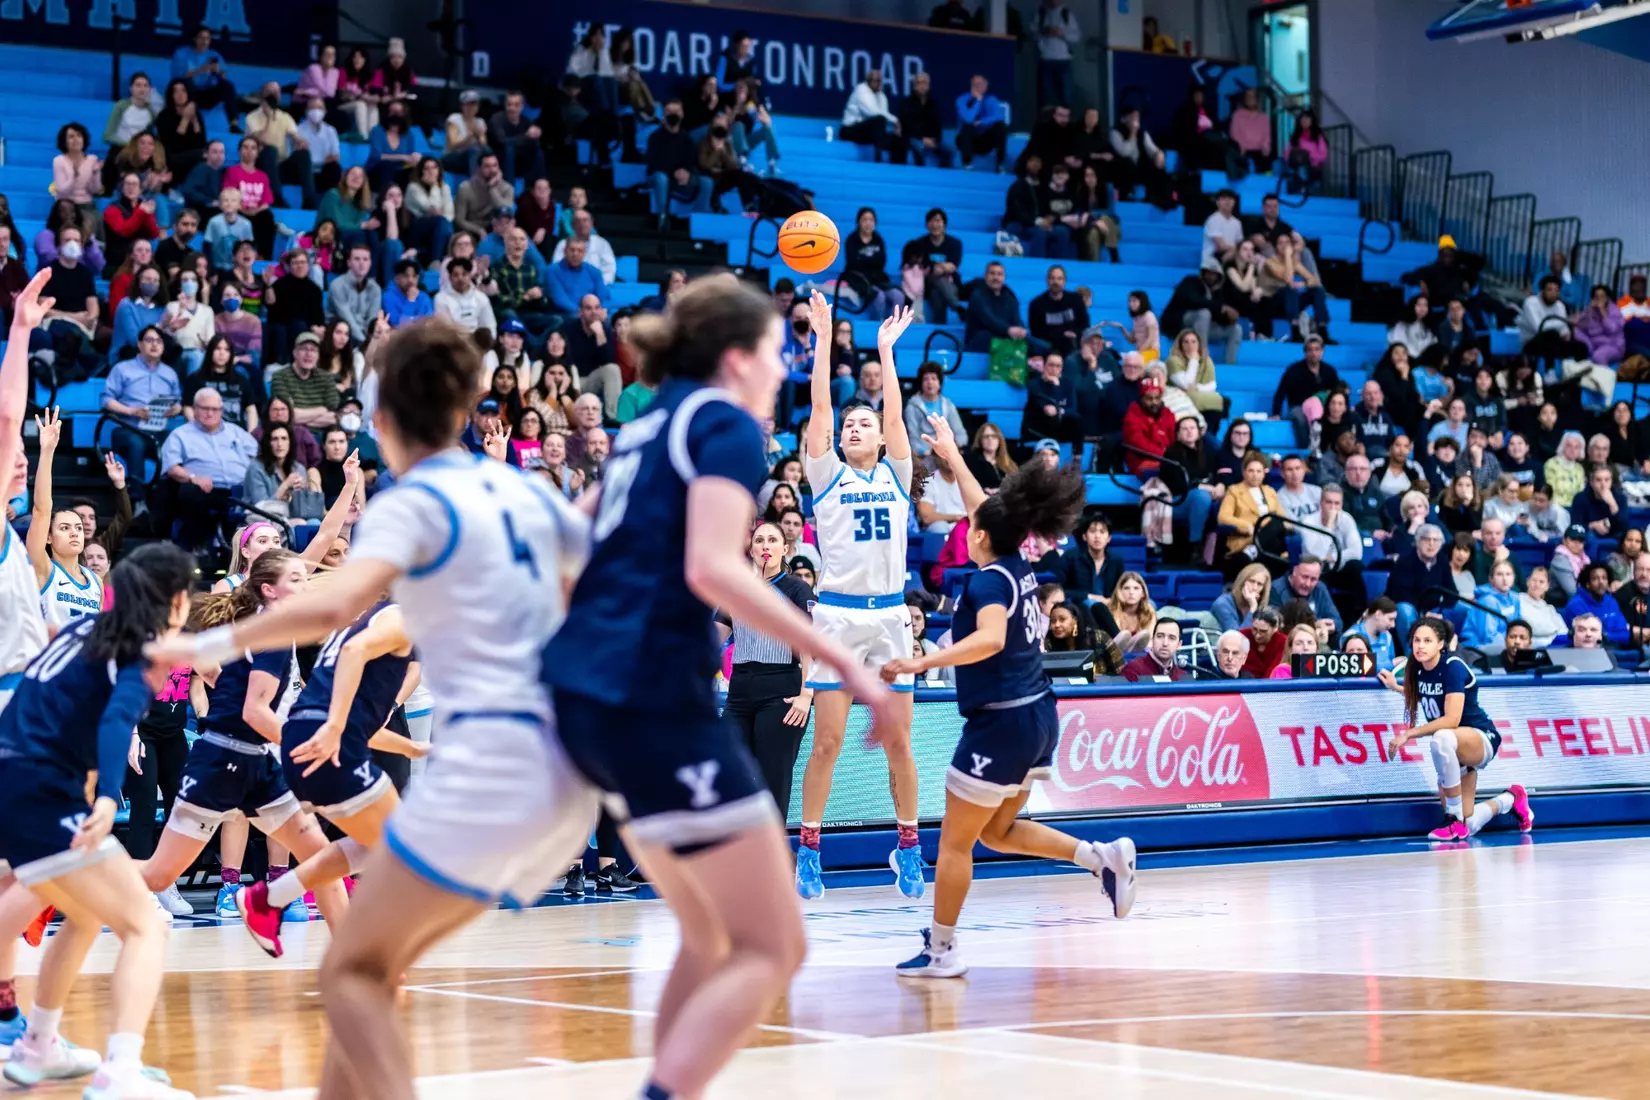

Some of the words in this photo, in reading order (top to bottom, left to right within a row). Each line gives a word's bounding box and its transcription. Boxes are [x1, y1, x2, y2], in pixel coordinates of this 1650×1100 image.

[852, 507, 892, 542] 35
[867, 597, 876, 609] C
[1315, 654, 1363, 676] POSS.
[1418, 681, 1443, 696] YALE
[1051, 704, 1244, 792] Coca-Cola
[1278, 724, 1425, 767] TASTE
[353, 760, 375, 787] Y
[970, 752, 993, 777] Y
[179, 775, 198, 798] Y
[675, 759, 721, 808] Y
[822, 820, 863, 828] DAKTRONICS
